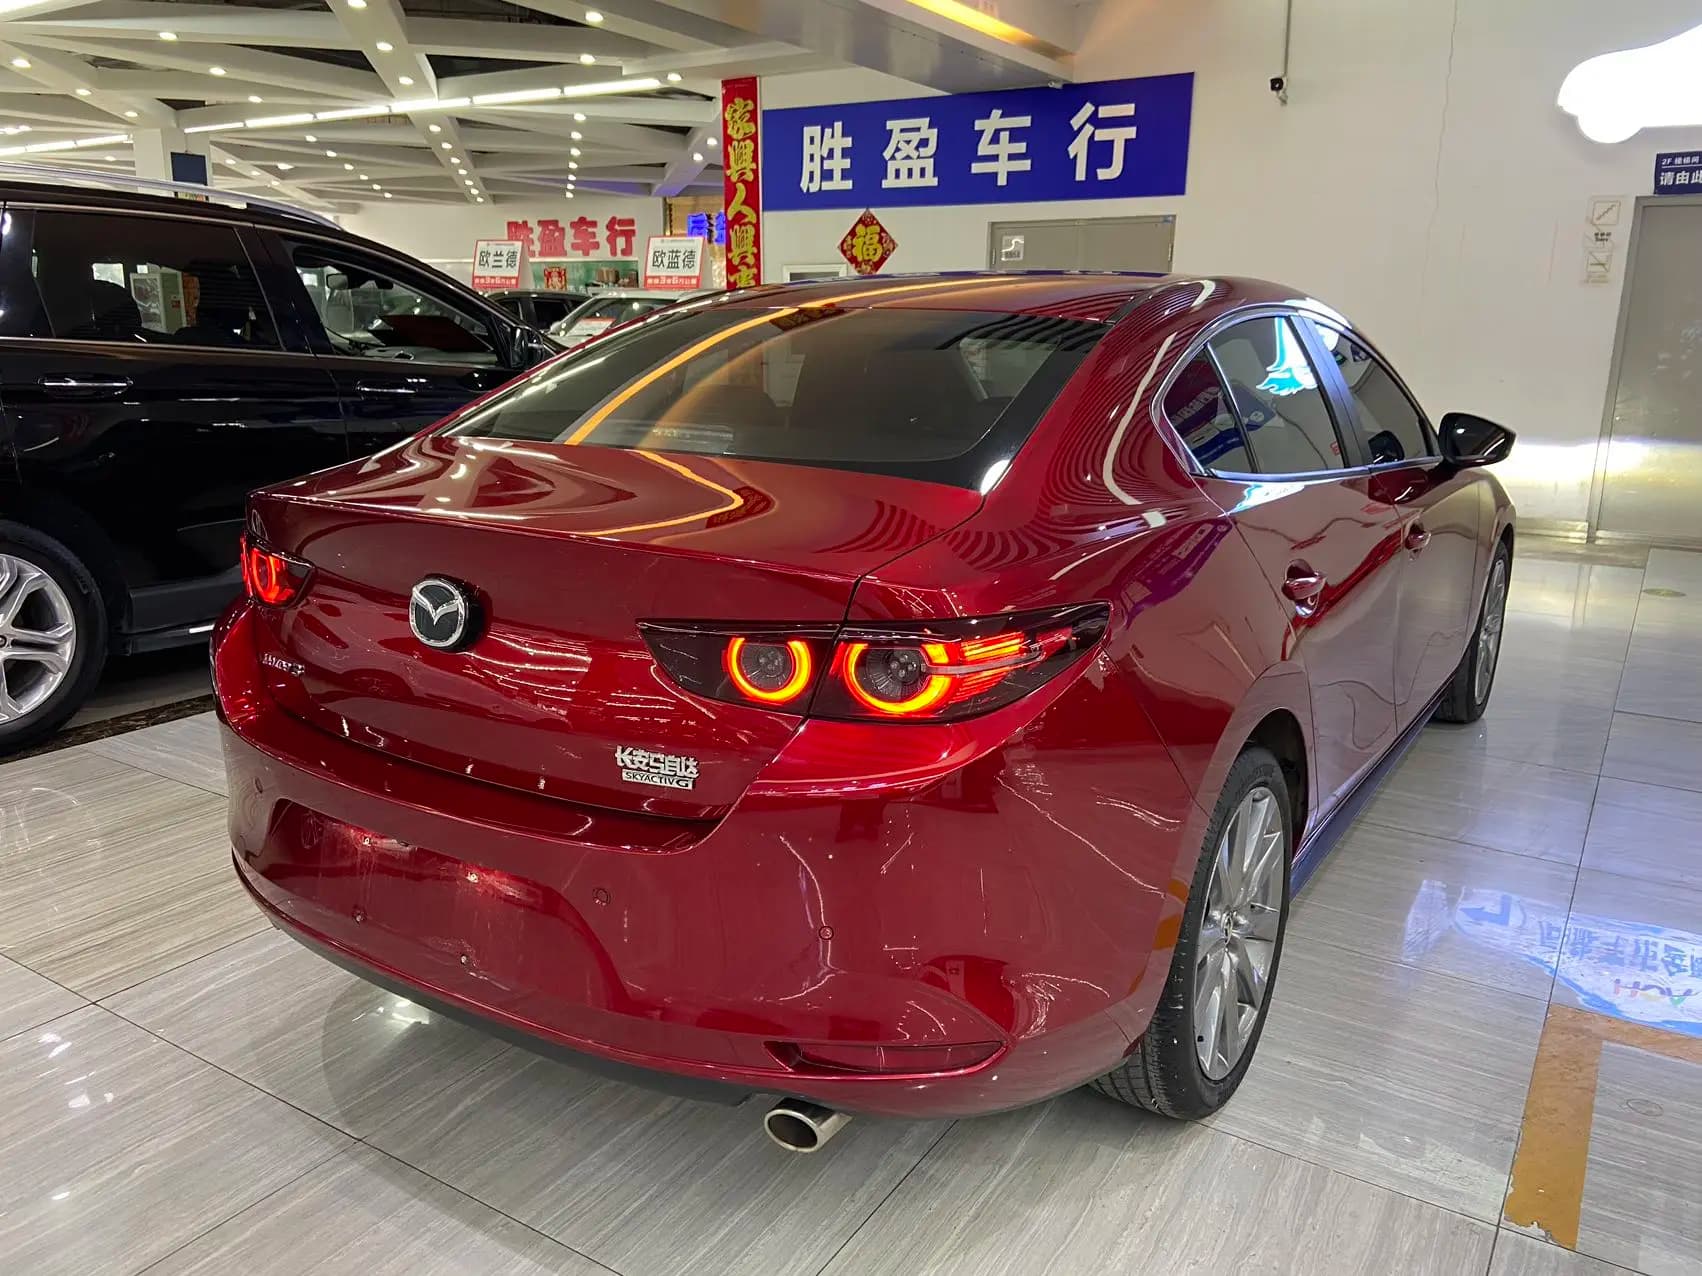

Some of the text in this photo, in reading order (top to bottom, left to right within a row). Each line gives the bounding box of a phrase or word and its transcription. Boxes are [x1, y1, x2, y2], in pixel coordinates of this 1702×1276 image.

[800, 102, 1137, 193] 胜盈车行
[507, 215, 636, 258] 胜盈车行
[852, 223, 883, 262] 福
[479, 249, 518, 269] 欧兰德
[652, 249, 696, 269] 欧蓝德
[615, 745, 700, 779] 长安马自达
